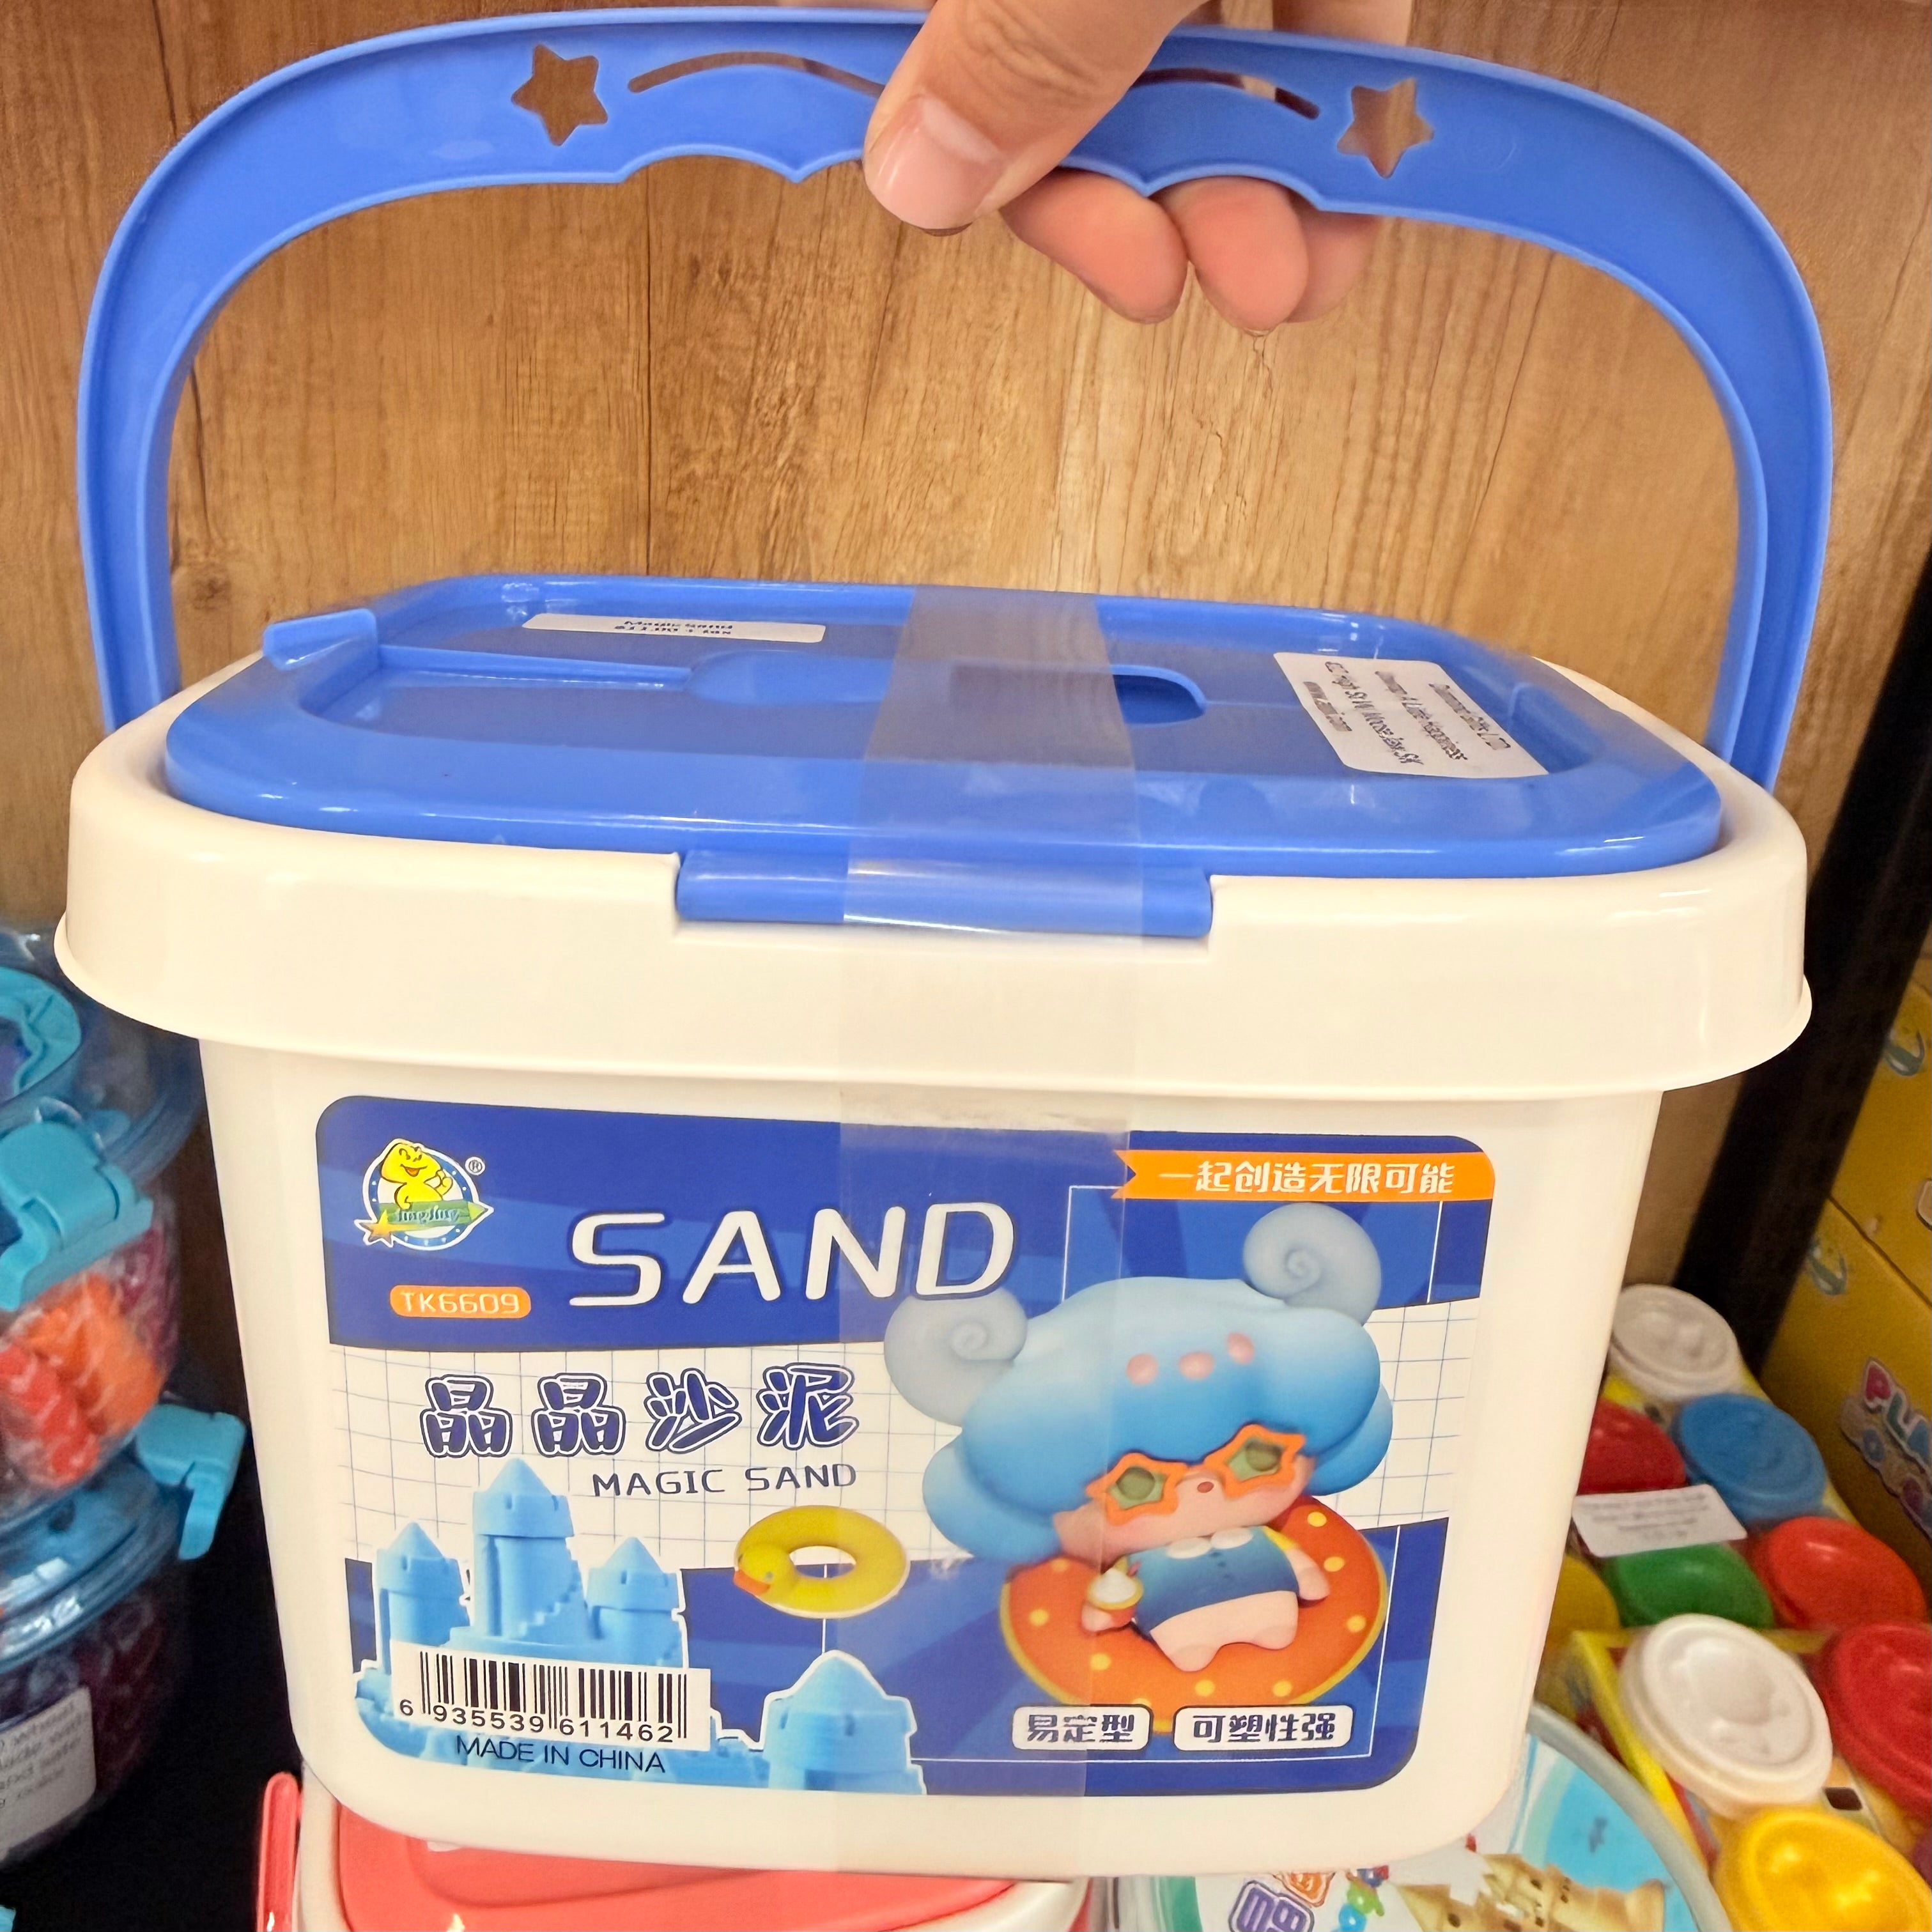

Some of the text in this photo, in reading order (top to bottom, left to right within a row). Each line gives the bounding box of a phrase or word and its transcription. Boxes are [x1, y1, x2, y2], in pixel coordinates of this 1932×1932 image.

[1159, 1161, 1455, 1193] 一起创造无限可能
[568, 1202, 1015, 1306] SAND
[400, 1291, 520, 1313] TK6609
[419, 1362, 860, 1458] 晶晶沙泥
[592, 1462, 858, 1497] MAGIC SAND
[399, 1699, 674, 1743] 6 935539 611462
[1026, 1713, 1135, 1743] 易定型
[1193, 1712, 1337, 1743] 可塑性强
[456, 1735, 666, 1774] MADE IN CHINA
